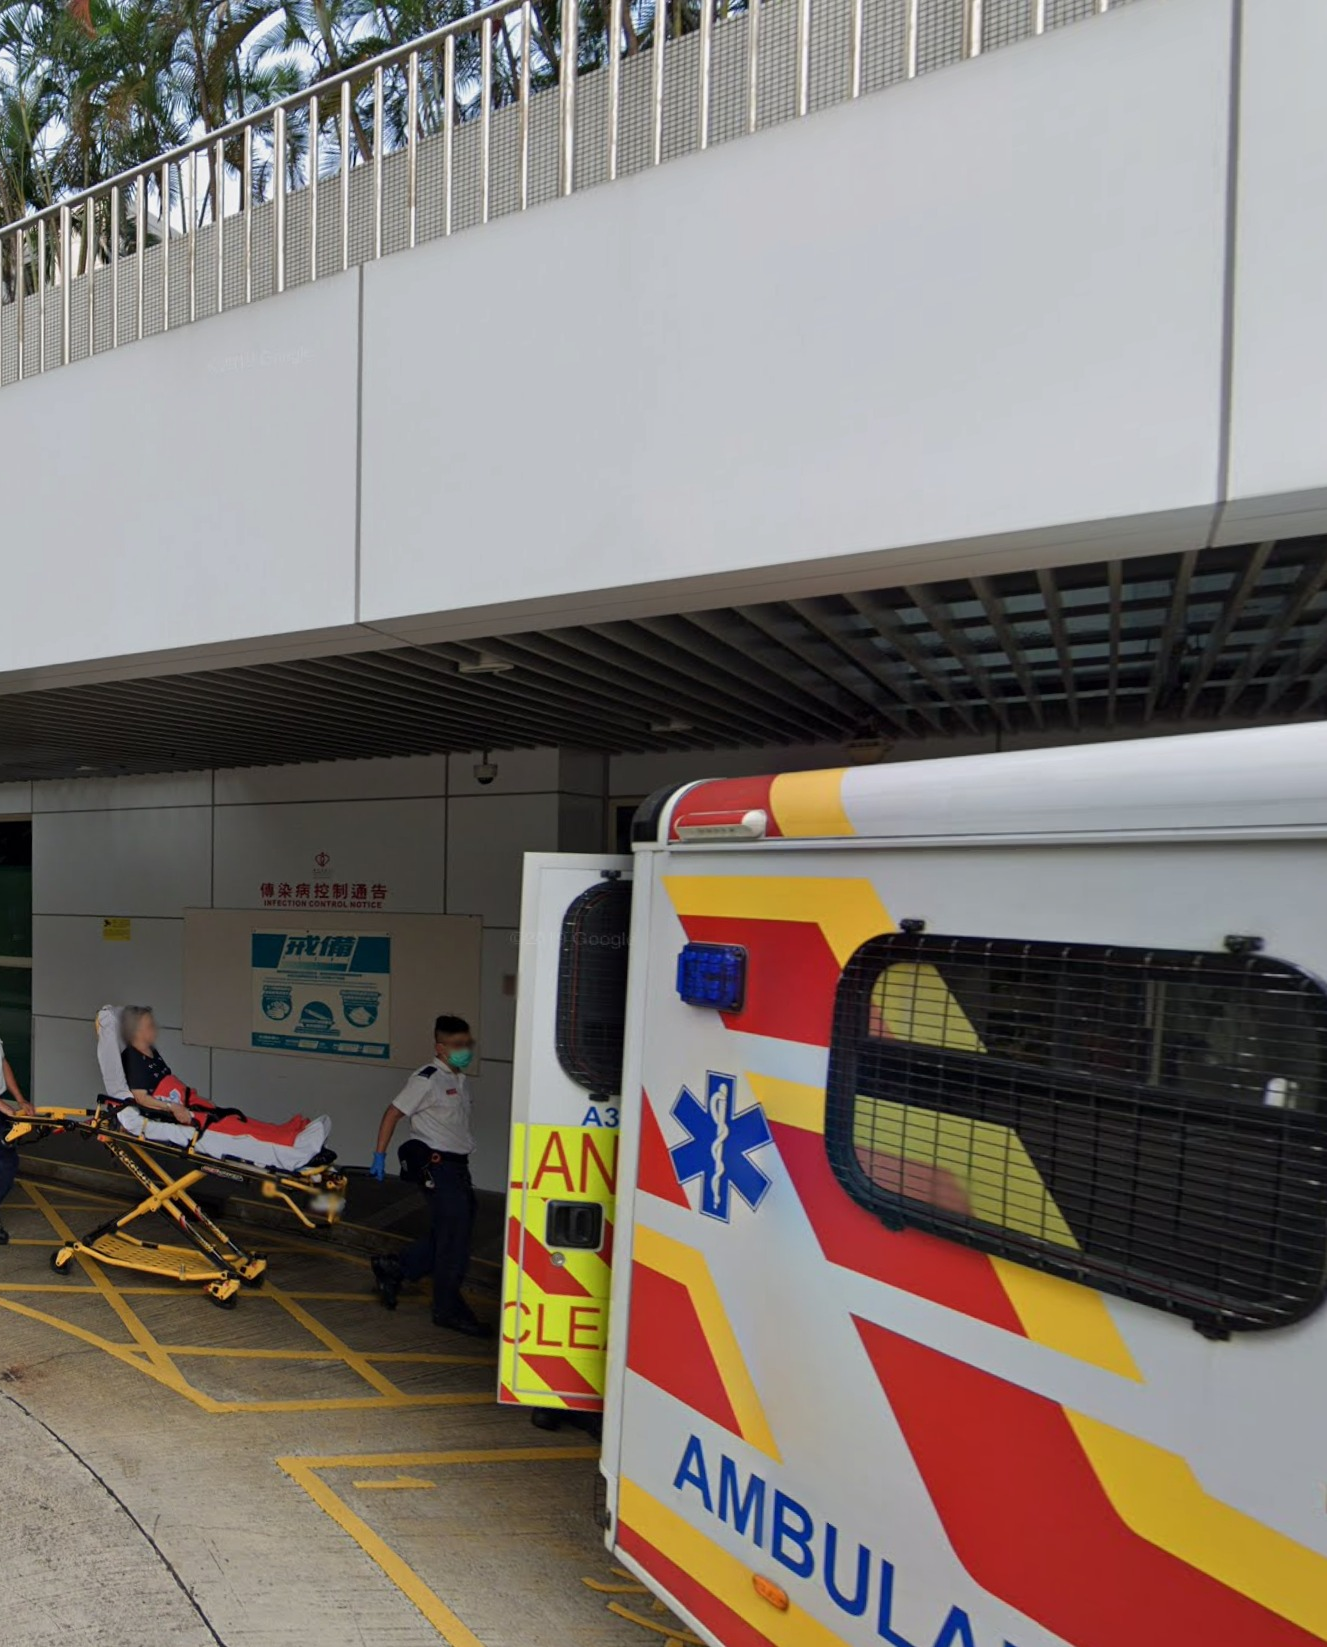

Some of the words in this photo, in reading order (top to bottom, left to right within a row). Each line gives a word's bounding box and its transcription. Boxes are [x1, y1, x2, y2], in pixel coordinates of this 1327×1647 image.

[260, 882, 388, 900] 傳染病控制通告
[264, 899, 307, 908] INFECTION
[309, 900, 347, 909] CONTROL
[350, 900, 384, 910] NOTICE
[284, 934, 358, 958] 戒備
[503, 1301, 607, 1351] CLE
[673, 1433, 1018, 1647] AMBUL
